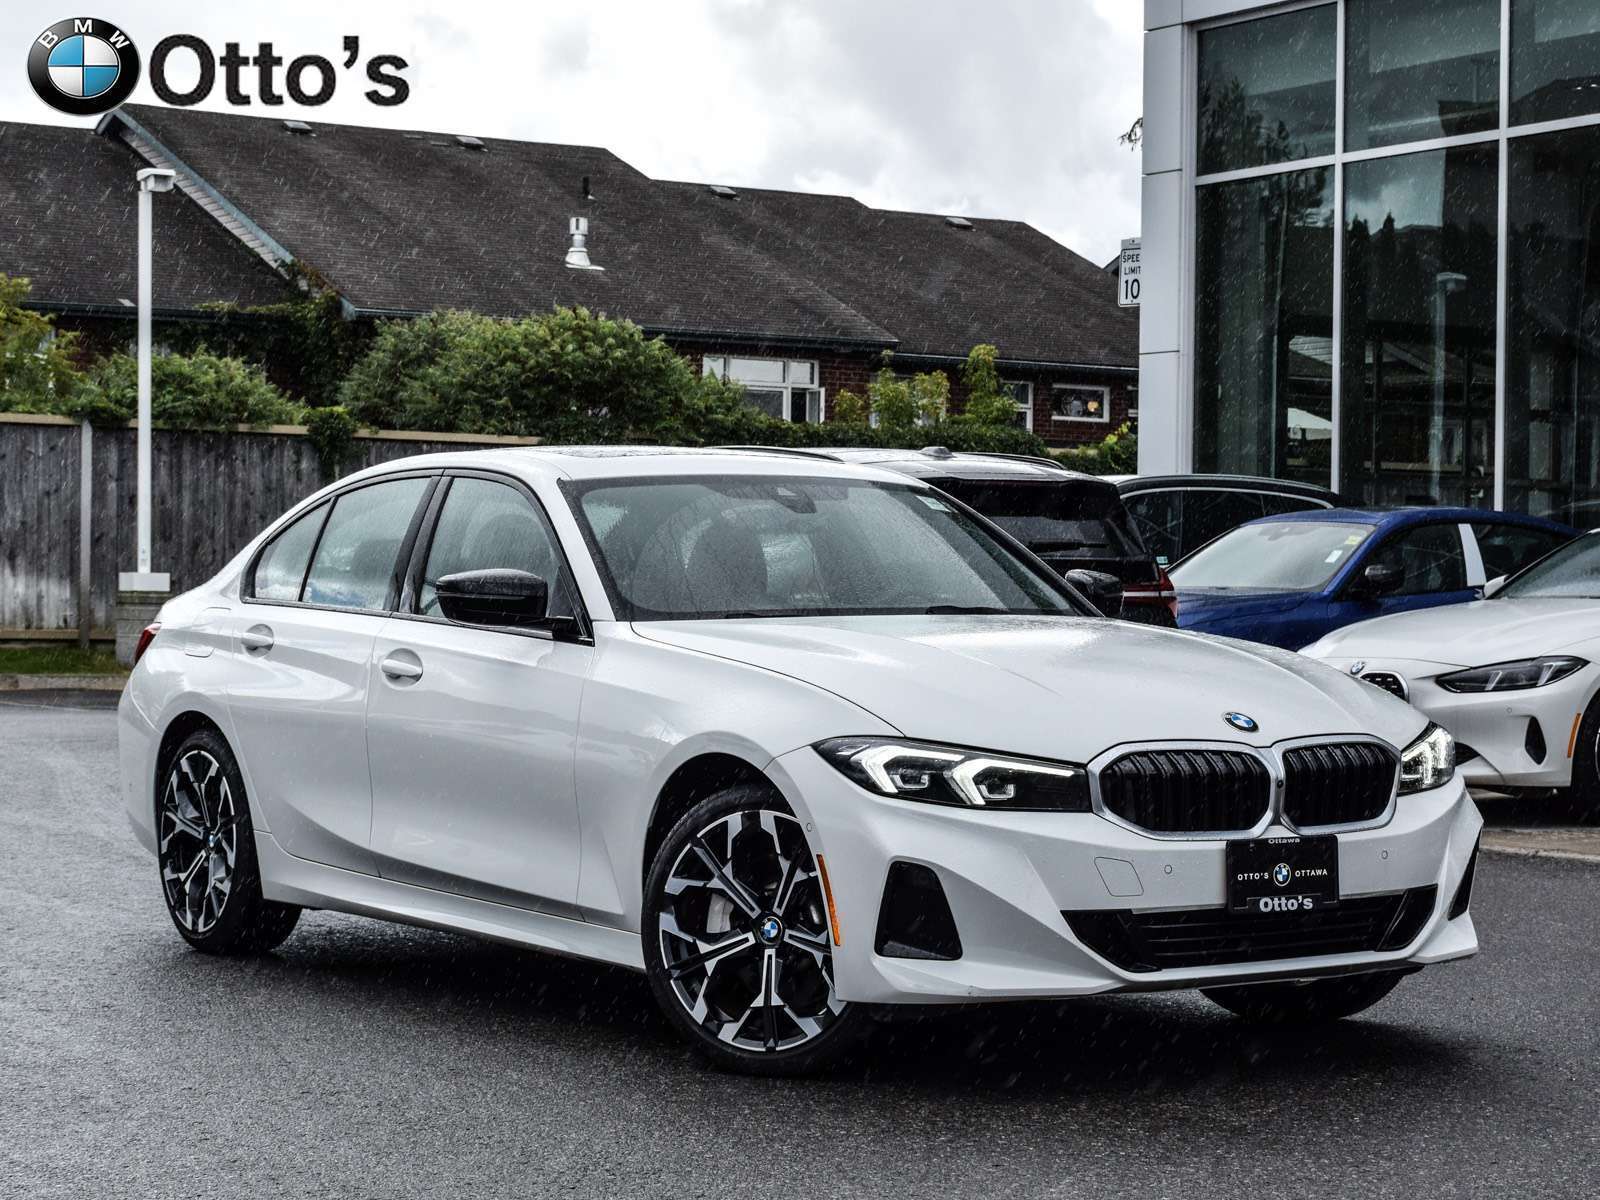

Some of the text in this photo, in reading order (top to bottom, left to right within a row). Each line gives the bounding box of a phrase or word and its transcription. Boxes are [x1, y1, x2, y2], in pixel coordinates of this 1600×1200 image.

[1122, 254, 1140, 263] SPEE
[1125, 278, 1140, 300] 10
[1237, 869, 1328, 881] OTTO'S OTTAWA
[1259, 895, 1313, 912] Otto's
